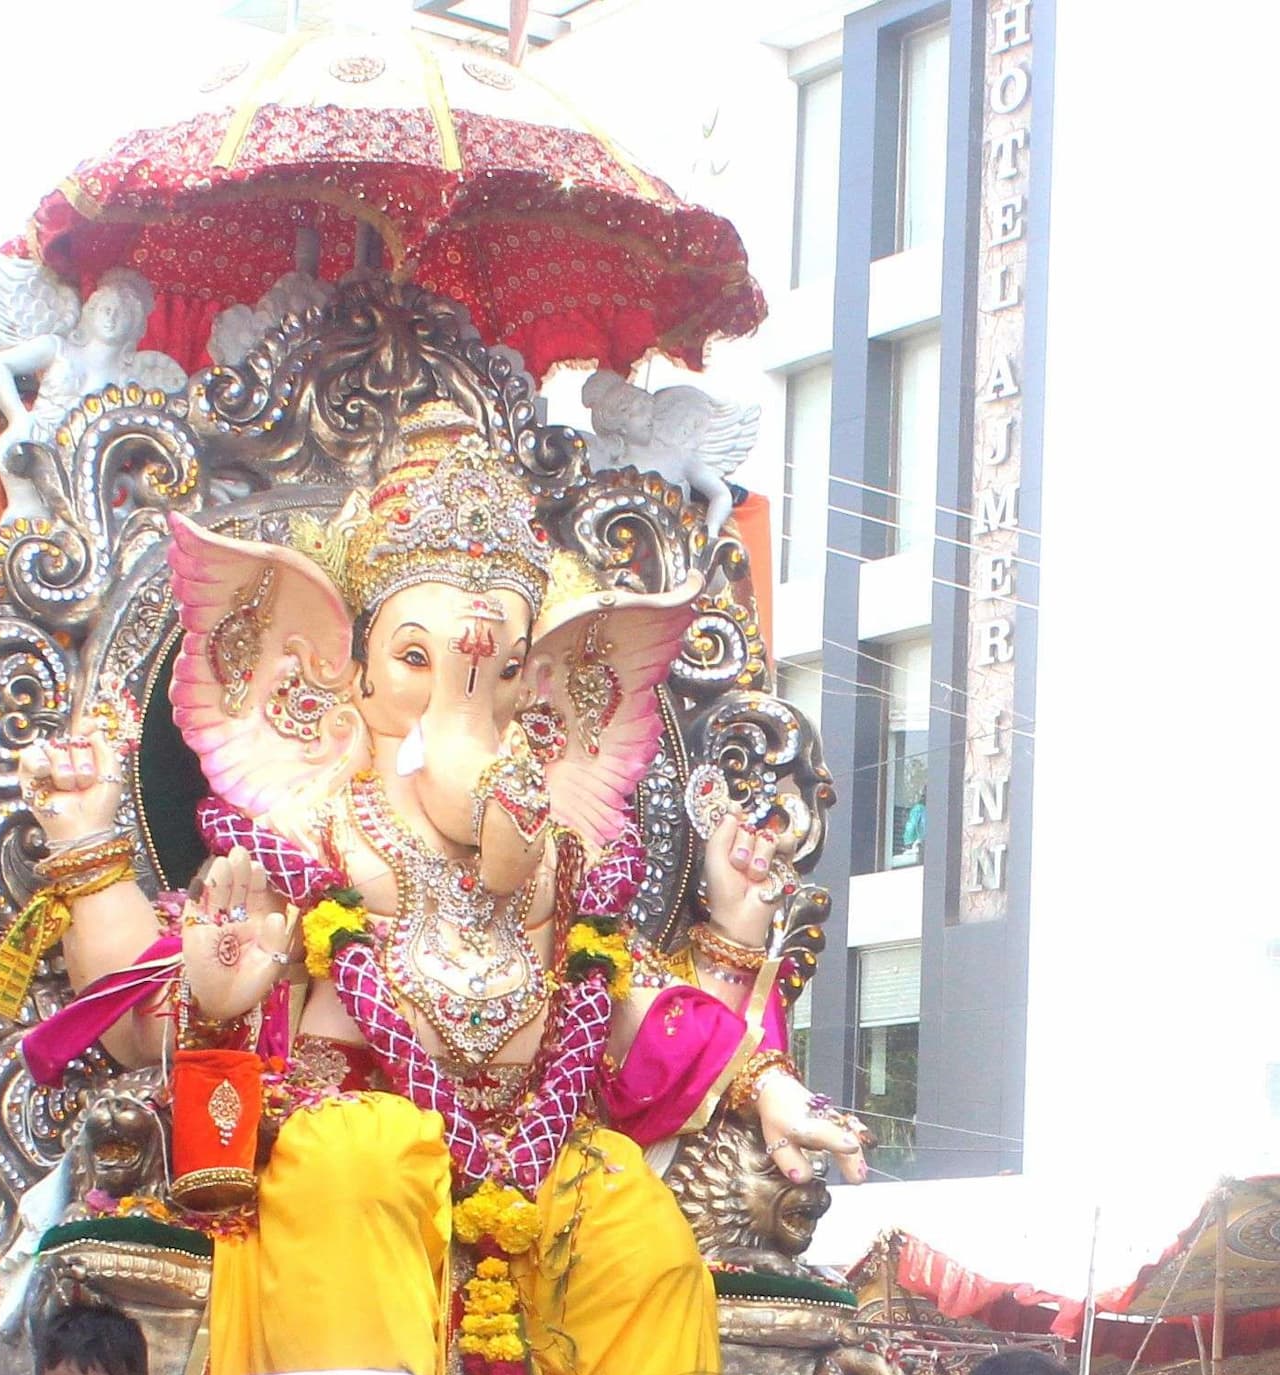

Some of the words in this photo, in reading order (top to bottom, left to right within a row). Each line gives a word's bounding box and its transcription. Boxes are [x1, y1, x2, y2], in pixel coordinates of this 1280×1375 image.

[989, 2, 1032, 311] HOTEL
[974, 353, 1020, 667] AJMER
[965, 708, 1009, 892] INN
